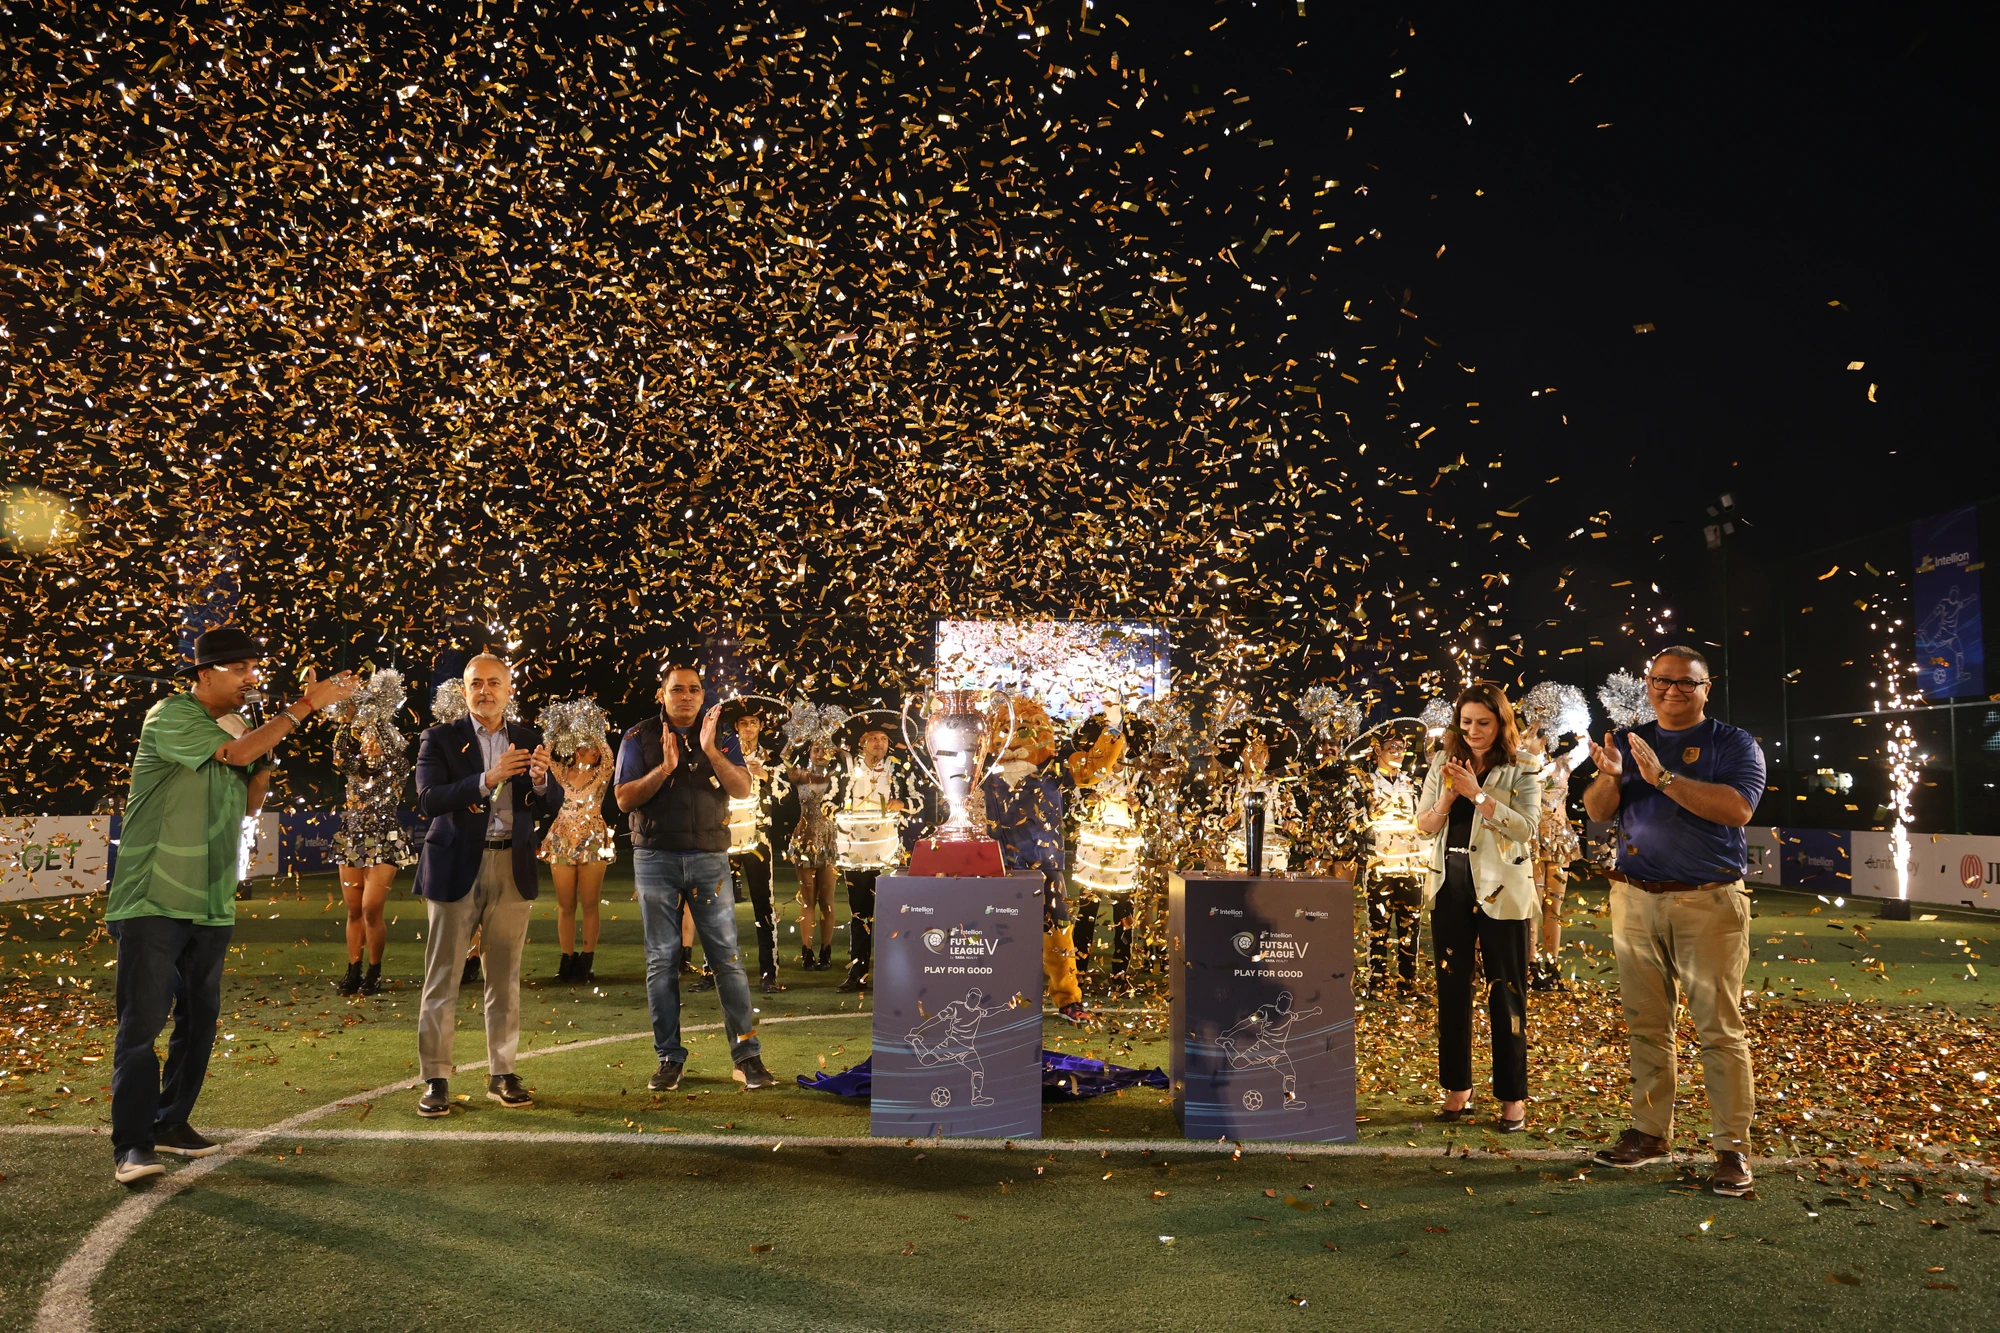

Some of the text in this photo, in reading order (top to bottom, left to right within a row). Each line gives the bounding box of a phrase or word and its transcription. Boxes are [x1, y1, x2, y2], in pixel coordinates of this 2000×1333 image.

[1934, 551, 1970, 567] Intellion
[22, 842, 81, 873] GET
[1747, 845, 1765, 864] ET
[950, 947, 985, 955] LEAGUE
[984, 938, 999, 956] V
[1294, 942, 1309, 959] V
[924, 966, 945, 974] PLAY
[967, 967, 993, 975] GOOD
[1234, 969, 1255, 977] PLAY
[1277, 970, 1303, 978] GOOD
